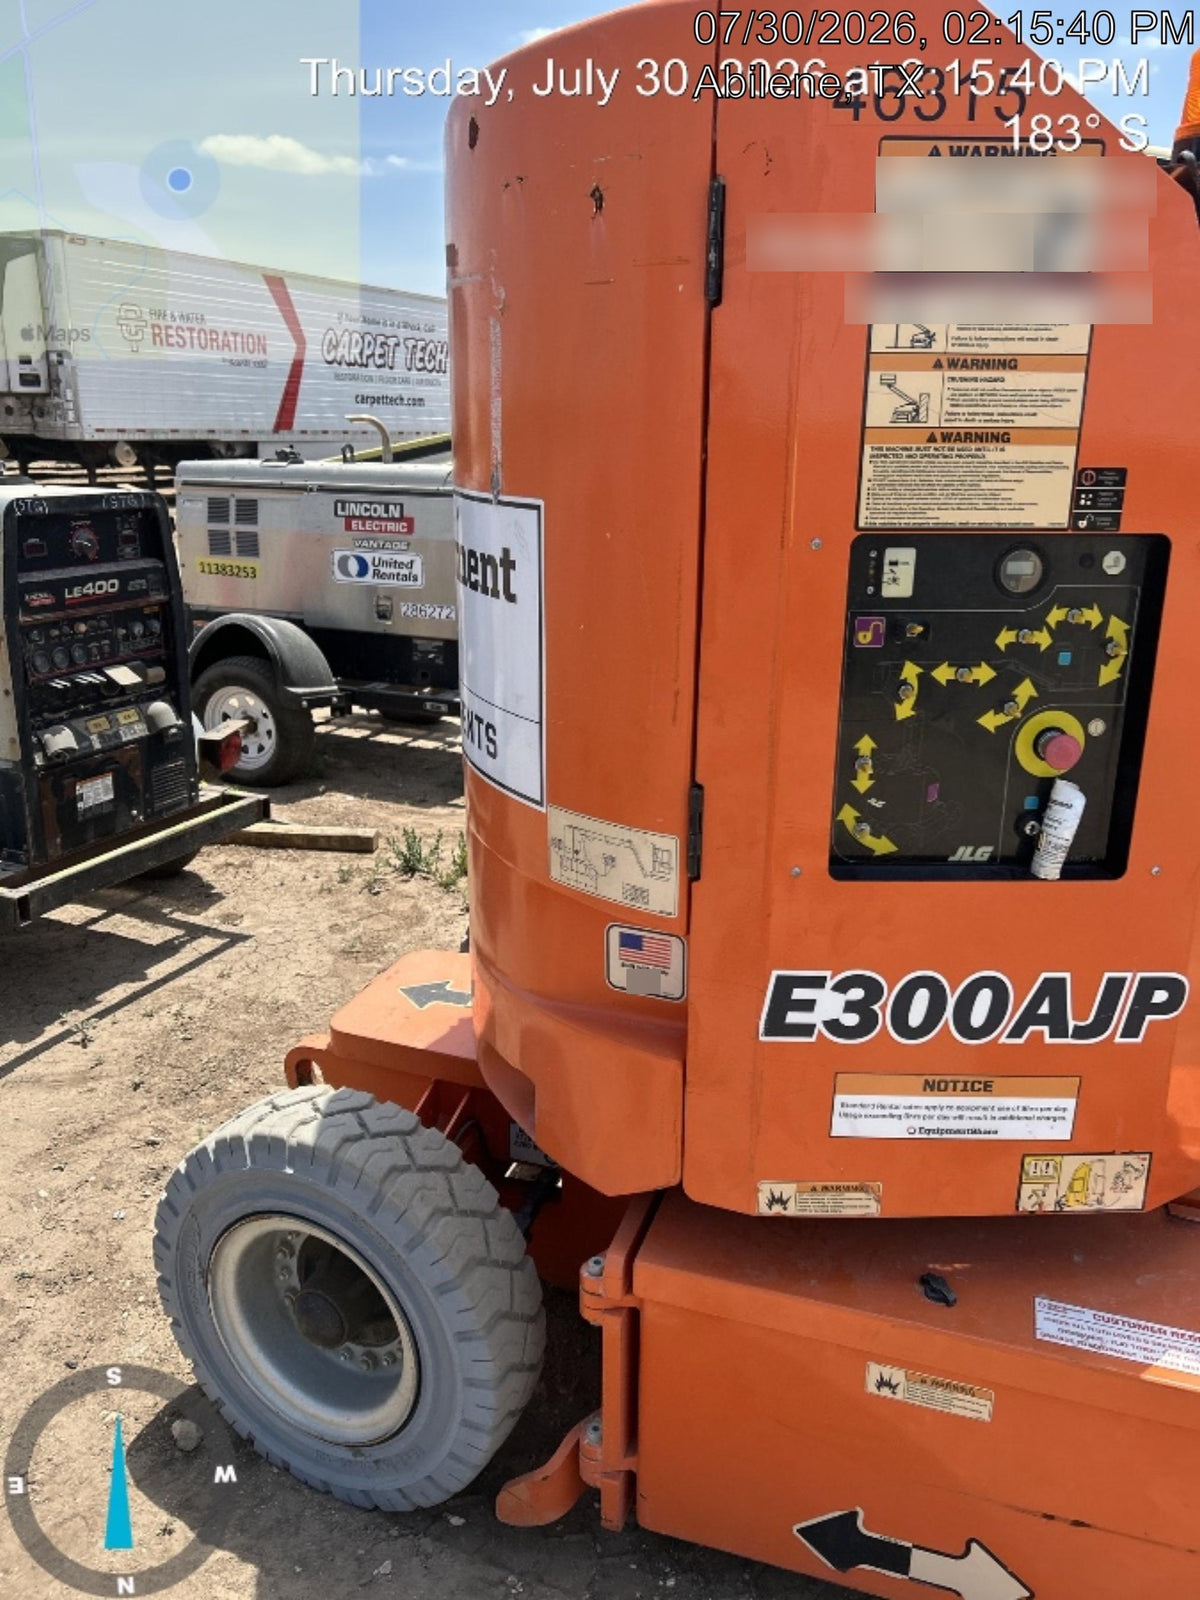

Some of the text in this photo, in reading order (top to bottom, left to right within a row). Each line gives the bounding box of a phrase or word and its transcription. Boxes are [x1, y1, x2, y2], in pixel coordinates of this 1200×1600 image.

[832, 67, 1028, 121] 46315
[151, 323, 268, 356] RESTORATION
[321, 327, 449, 374] CARPET TECH
[946, 358, 1019, 371] WARNING
[354, 393, 426, 408] carpettech.com
[940, 431, 1012, 444] WARNING
[336, 502, 401, 518] LINCOLN
[351, 519, 408, 533] ELECTRIC
[353, 538, 409, 550] VANTAGE
[199, 561, 257, 579] 11383253
[371, 556, 415, 570] United
[371, 569, 419, 584] Rentals
[64, 578, 120, 599] LE400
[948, 845, 996, 862] JLG
[759, 970, 1189, 1044] E300AJP
[922, 1078, 995, 1093] NOTICE
[1092, 1312, 1168, 1337] CUSTOMER
